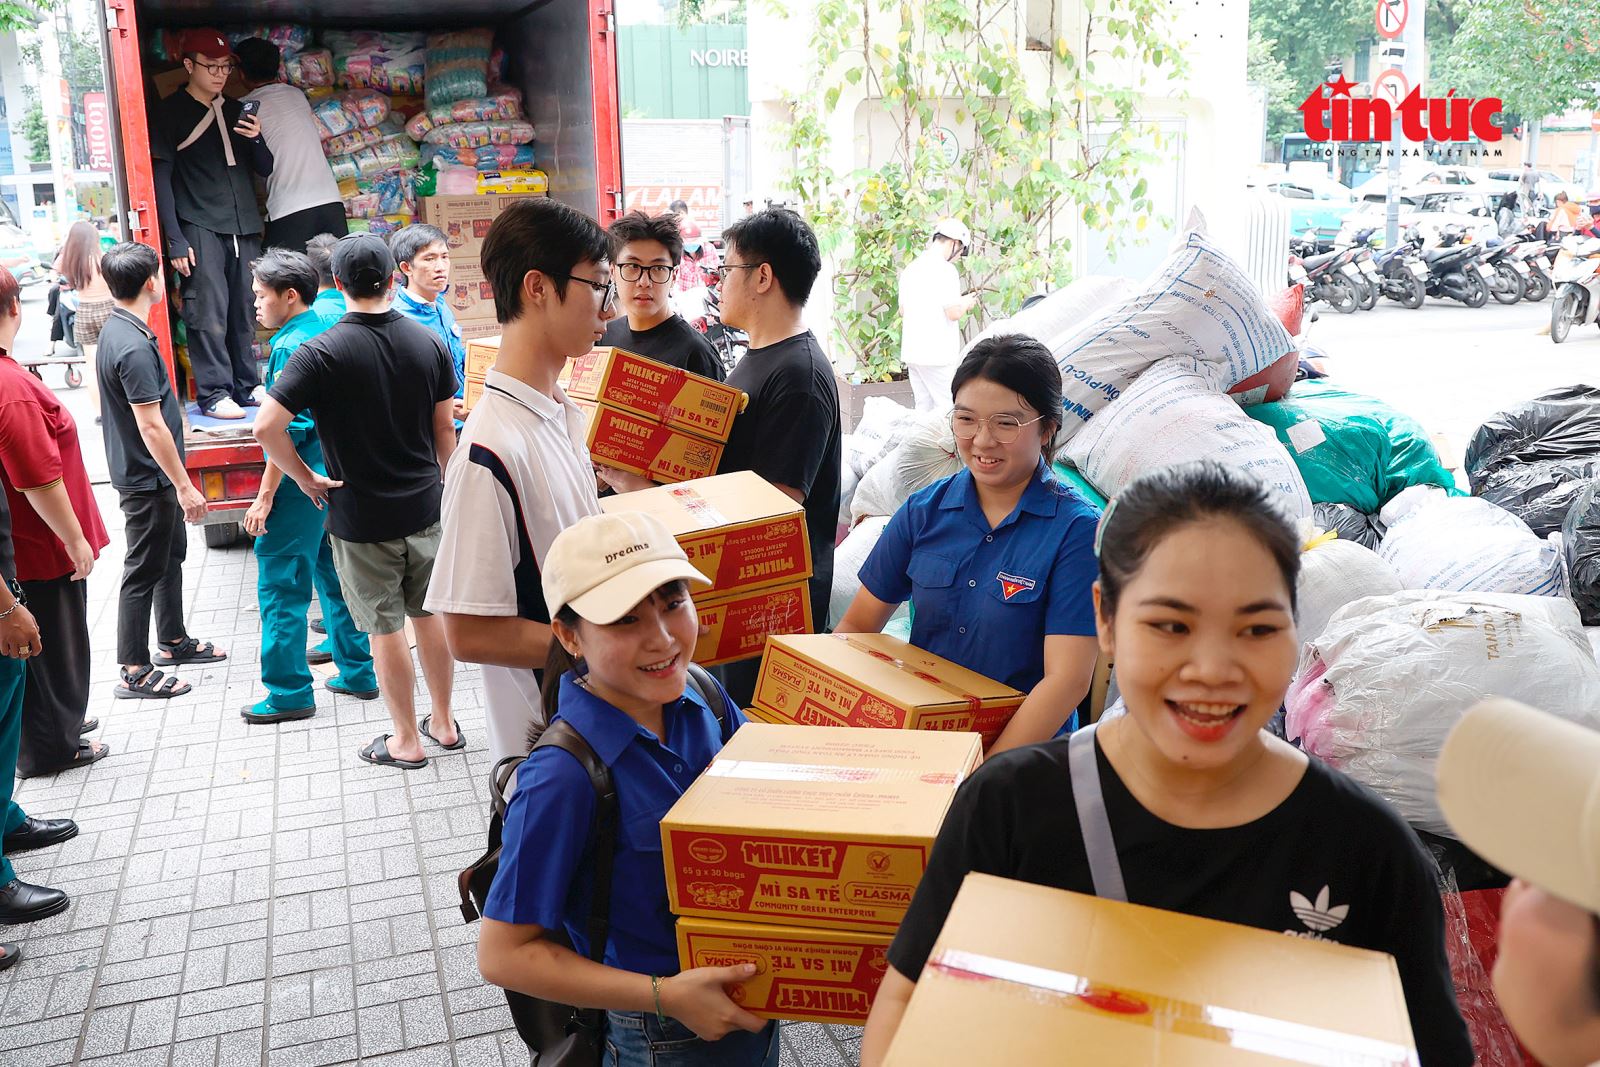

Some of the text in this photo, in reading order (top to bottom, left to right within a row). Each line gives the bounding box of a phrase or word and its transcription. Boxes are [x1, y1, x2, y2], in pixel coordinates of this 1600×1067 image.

[622, 361, 668, 385] MILIKET
[1061, 364, 1102, 390] PVC-U
[610, 416, 654, 439] MILIKET
[688, 410, 702, 424] SA
[705, 416, 720, 429] TẾ
[657, 459, 671, 472] MÌ
[673, 464, 686, 476] SA
[605, 543, 650, 564] Dreams
[683, 543, 717, 559] MÌ S
[739, 556, 795, 579] MILIKET
[772, 666, 802, 686] PLASMA
[806, 680, 852, 711] MÌ SA TẾ
[942, 719, 954, 729] SA
[742, 842, 837, 872] MILIKET
[683, 866, 693, 874] 65
[696, 869, 701, 877] g
[724, 870, 745, 880] bags
[760, 882, 781, 897] MÌ
[787, 886, 810, 900] SA
[816, 884, 841, 902] TẾ
[854, 888, 912, 902] PLASMA
[754, 901, 876, 917] COMMUNITY GREEN ENTERPRISE
[770, 955, 852, 977] MÌ SA TẾ
[779, 985, 868, 1013] MILIKET
